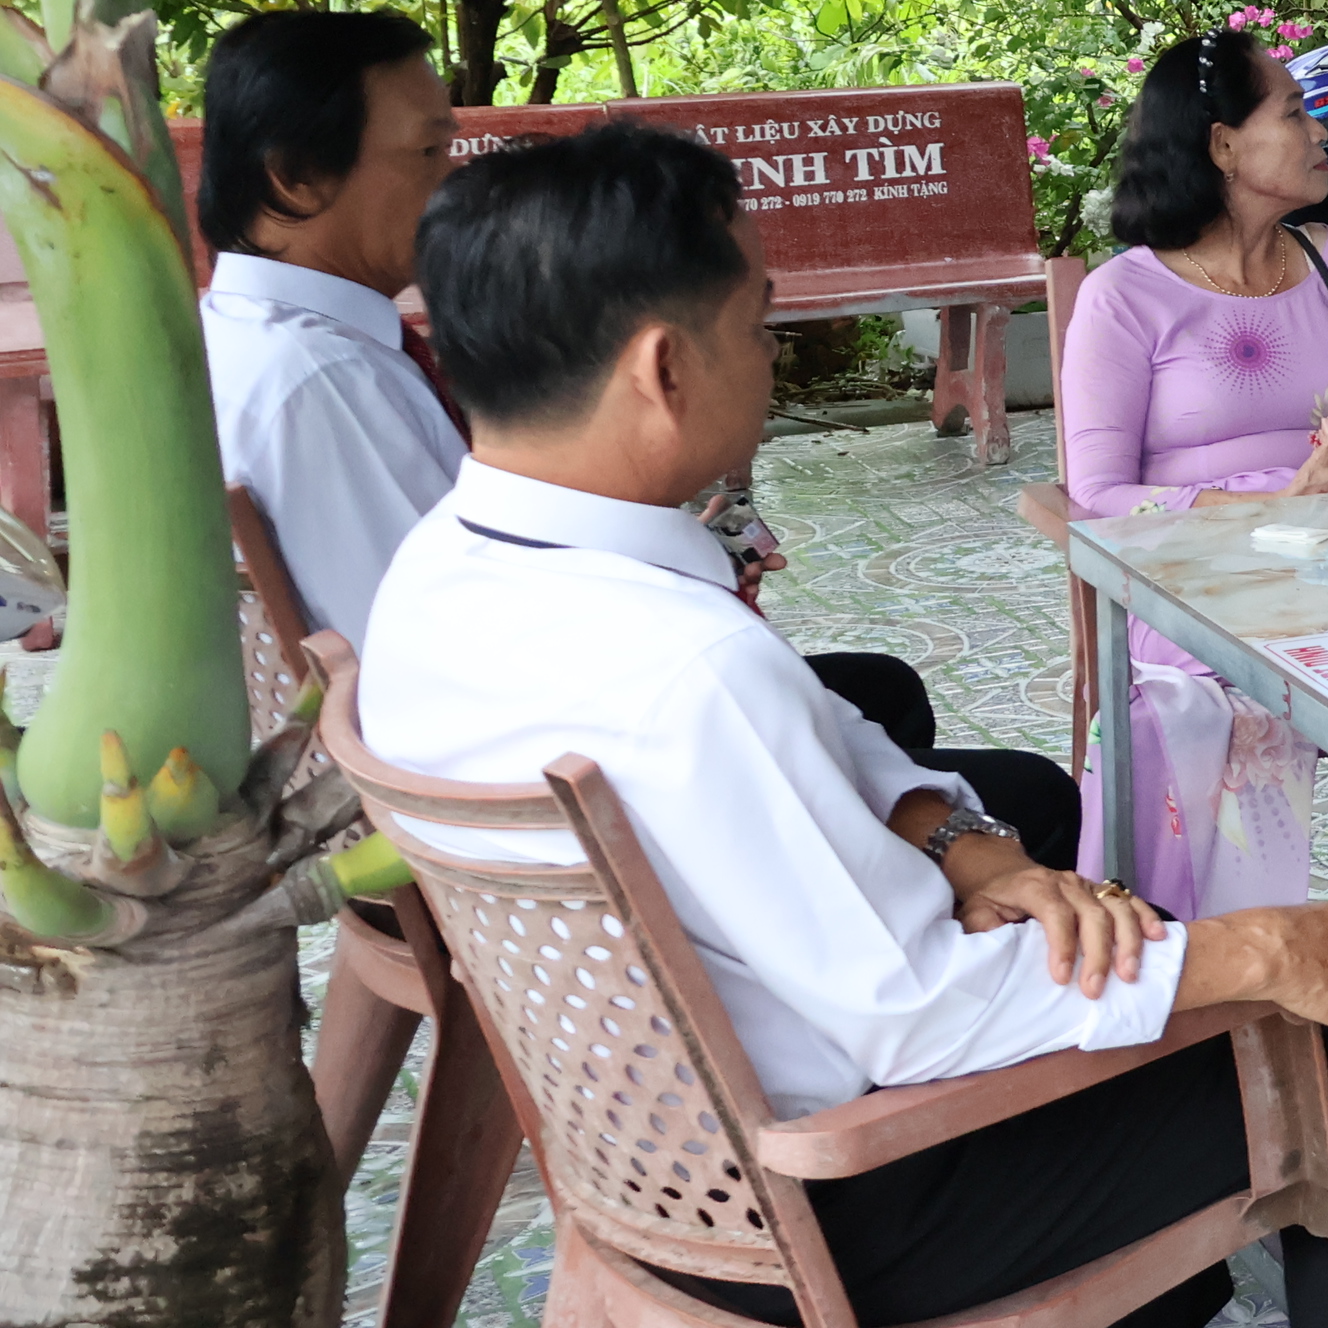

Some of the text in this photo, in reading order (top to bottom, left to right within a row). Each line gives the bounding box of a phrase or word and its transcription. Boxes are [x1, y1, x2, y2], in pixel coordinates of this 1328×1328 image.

[734, 119, 800, 144] LIỆU
[806, 114, 859, 138] XÂY
[866, 110, 942, 135] DỰNG
[845, 136, 947, 182] TÌM
[760, 196, 783, 210] 272
[792, 192, 820, 207] 0919
[846, 188, 868, 203] 272
[873, 183, 909, 201] KÍNH
